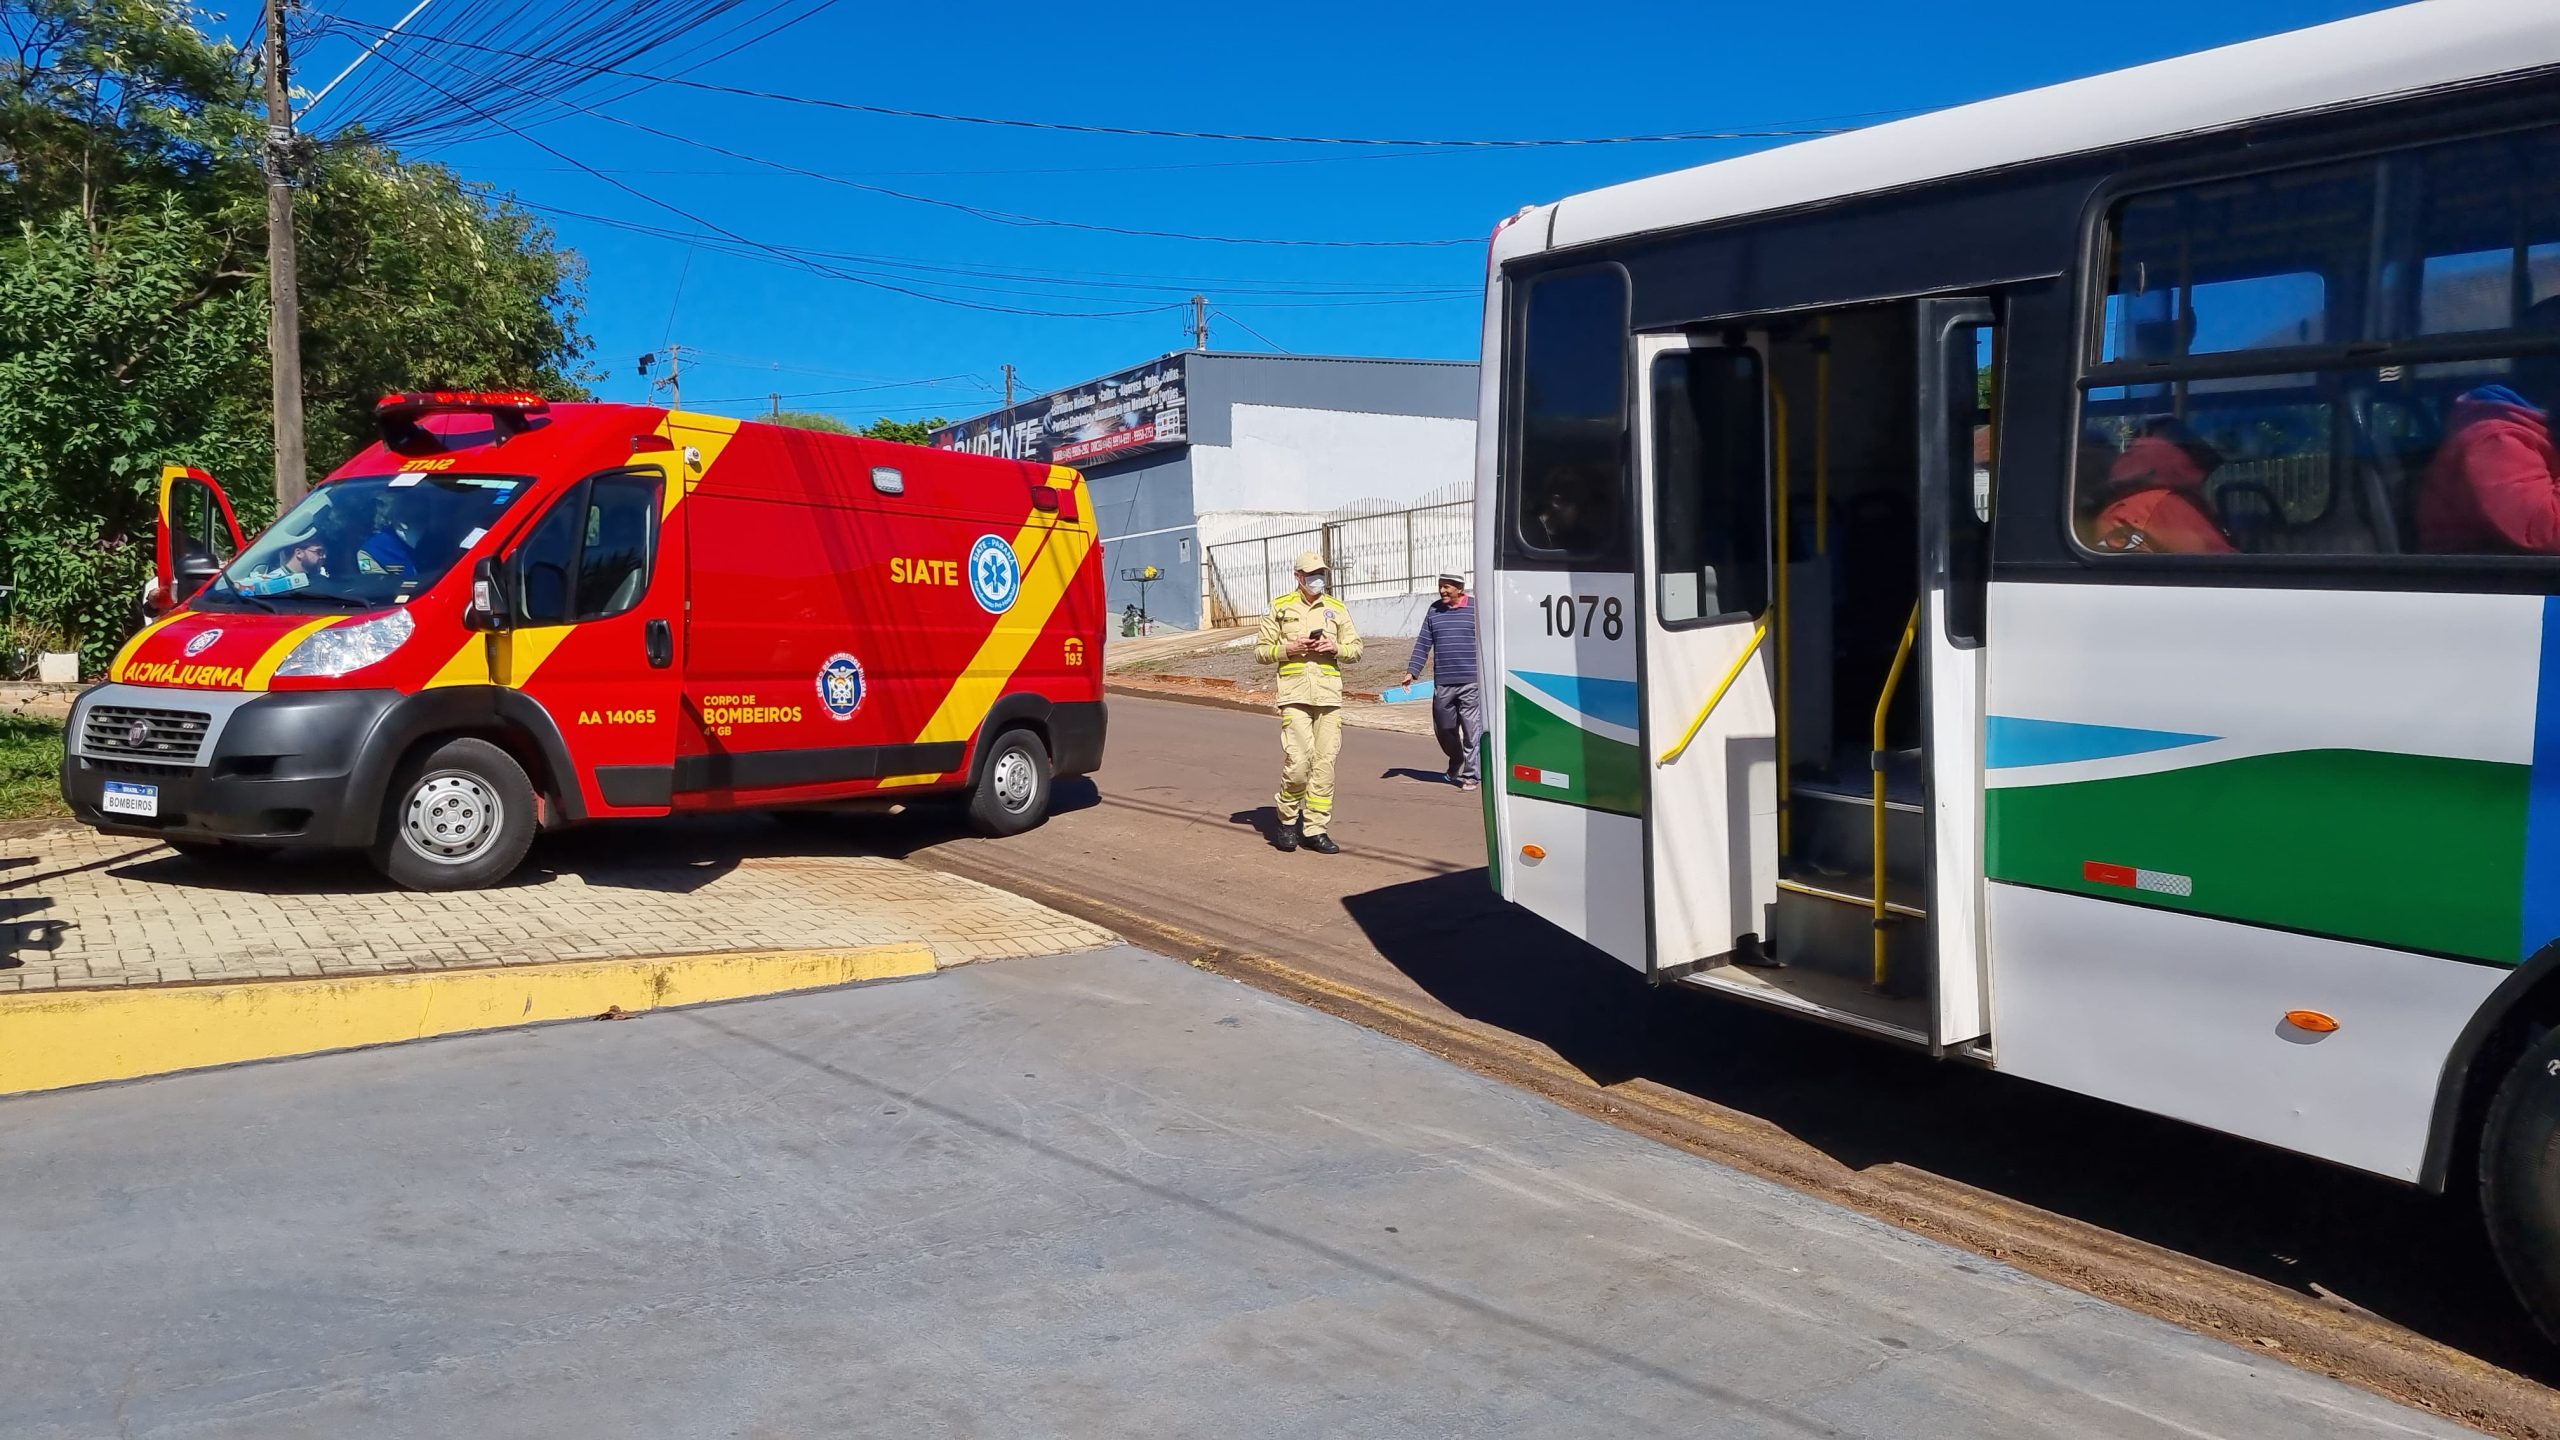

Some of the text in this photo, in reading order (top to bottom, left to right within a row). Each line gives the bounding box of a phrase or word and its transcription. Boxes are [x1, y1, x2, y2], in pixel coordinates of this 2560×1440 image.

[942, 418, 1039, 460] DENTE
[973, 540, 988, 563] SIATE
[890, 557, 959, 586] SIATE
[1539, 594, 1624, 641] 1078
[1064, 652, 1083, 666] 193
[815, 671, 824, 698] CORPO
[822, 660, 831, 671] DE
[829, 652, 861, 667] BOMBEIROS
[703, 694, 756, 706] CORPO DE
[578, 709, 656, 725] AA 14065
[703, 706, 802, 724] BOMBEIROS
[717, 726, 732, 736] GB
[109, 796, 153, 811] BOMBEIROS
